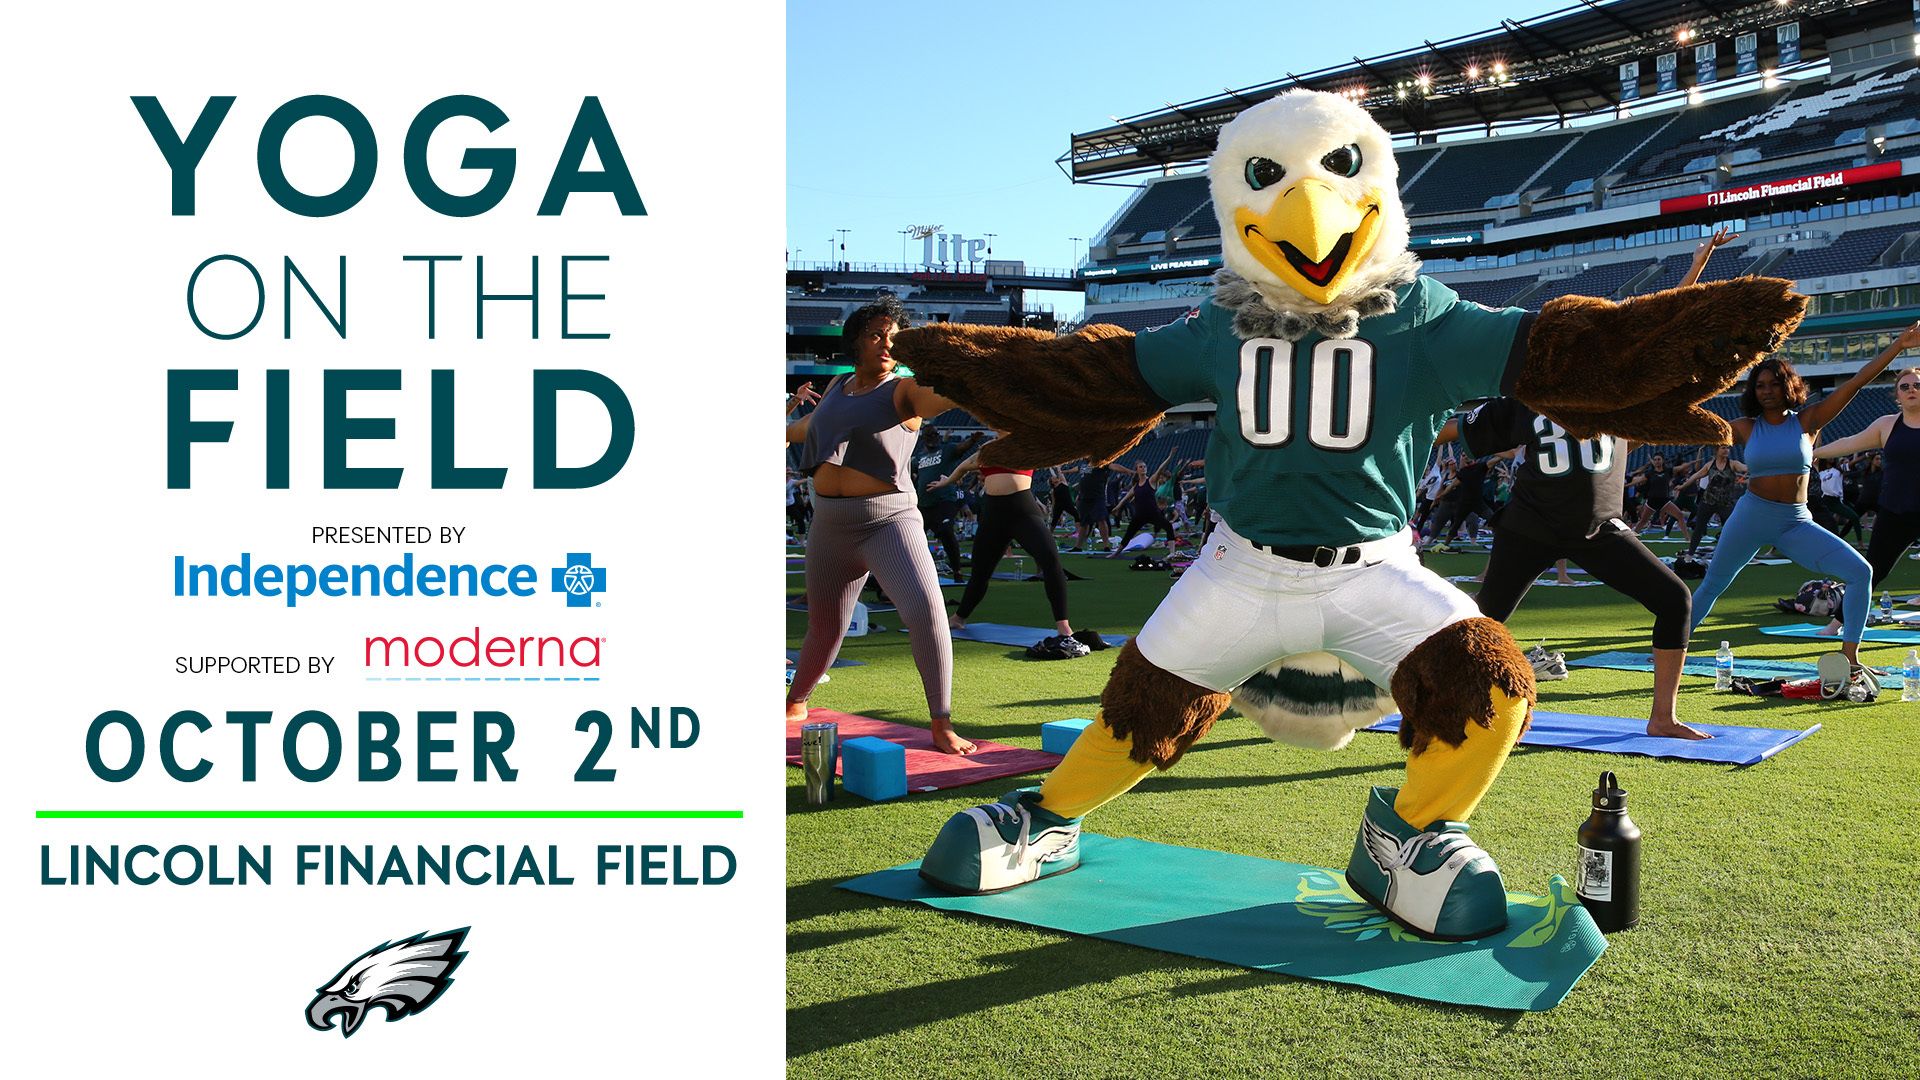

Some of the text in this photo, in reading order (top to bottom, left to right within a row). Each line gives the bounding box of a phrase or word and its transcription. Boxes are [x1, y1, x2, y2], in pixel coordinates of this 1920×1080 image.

[1779, 24, 1798, 43] 70
[1697, 45, 1715, 63] 44
[1625, 64, 1634, 80] 5
[1720, 172, 1843, 205] Lincoln Financial Field
[906, 224, 944, 239] Miller
[920, 232, 986, 271] Lite
[1150, 262, 1168, 271] LIVE
[1237, 337, 1375, 452] 00
